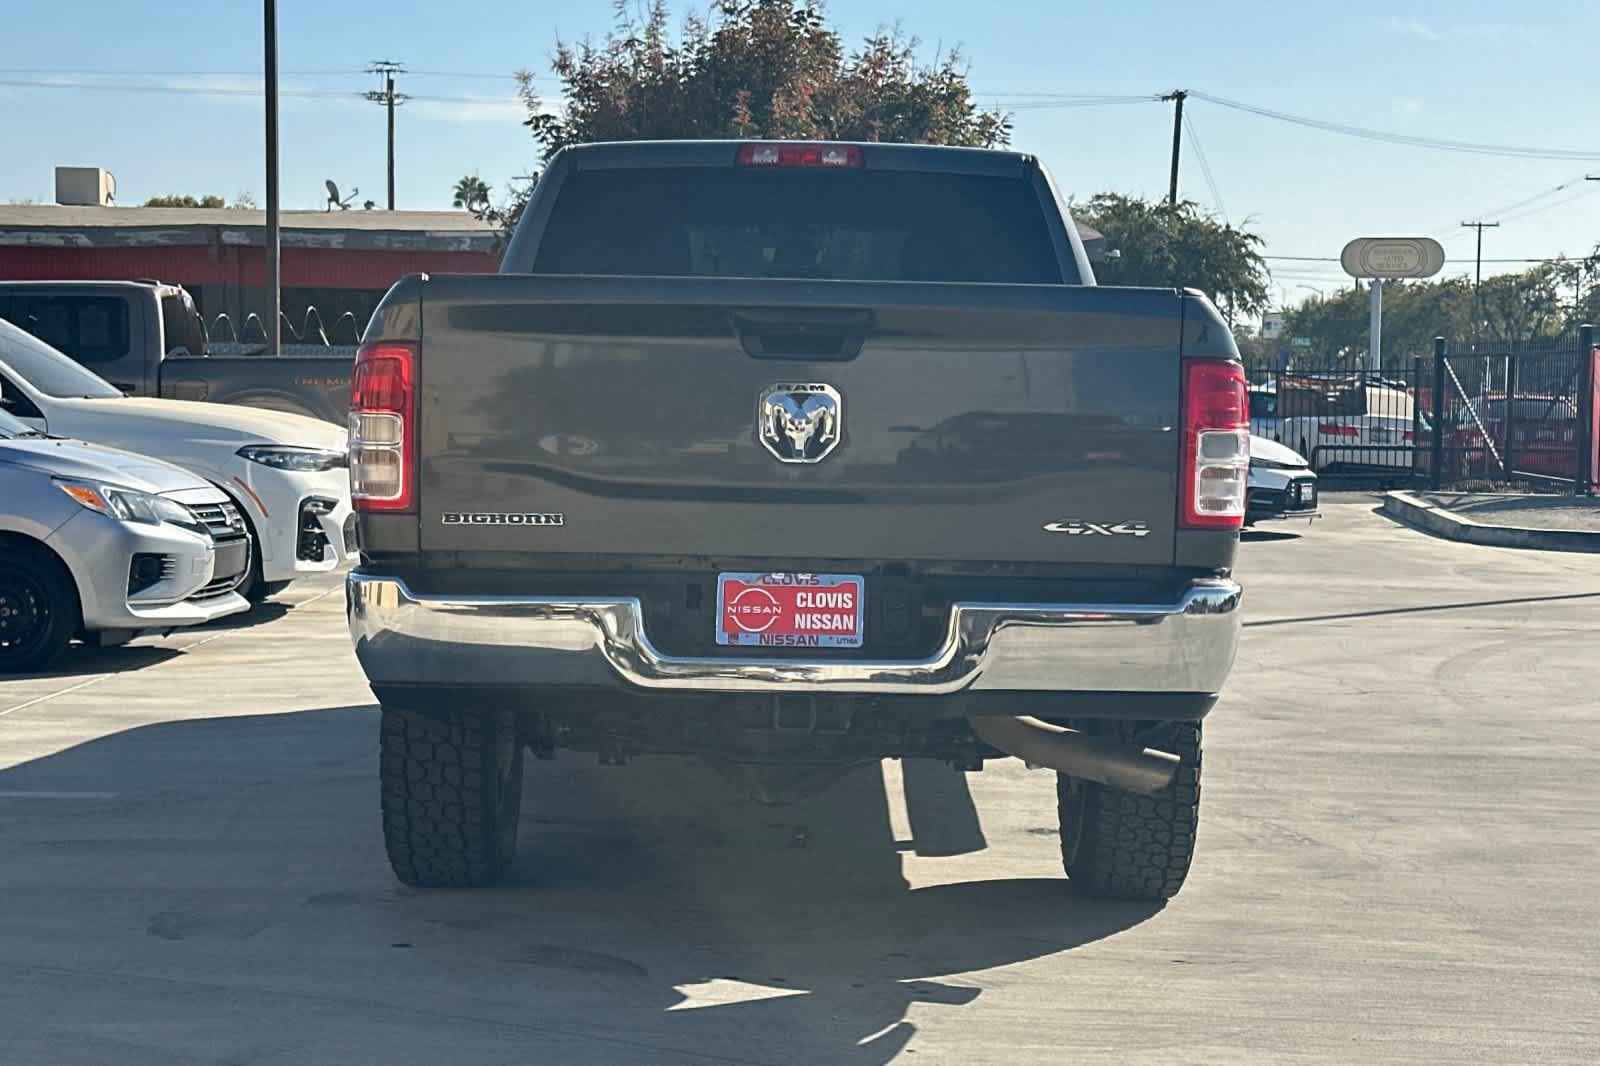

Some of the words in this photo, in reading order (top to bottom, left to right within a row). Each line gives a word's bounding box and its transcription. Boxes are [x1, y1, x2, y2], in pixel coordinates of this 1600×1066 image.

[441, 512, 564, 526] BIGHORN
[762, 574, 821, 586] CLOVIS
[796, 592, 853, 609] CLOVIS
[727, 605, 783, 615] NISSAN
[794, 613, 854, 631] NISSAN
[759, 634, 819, 647] NISSAN
